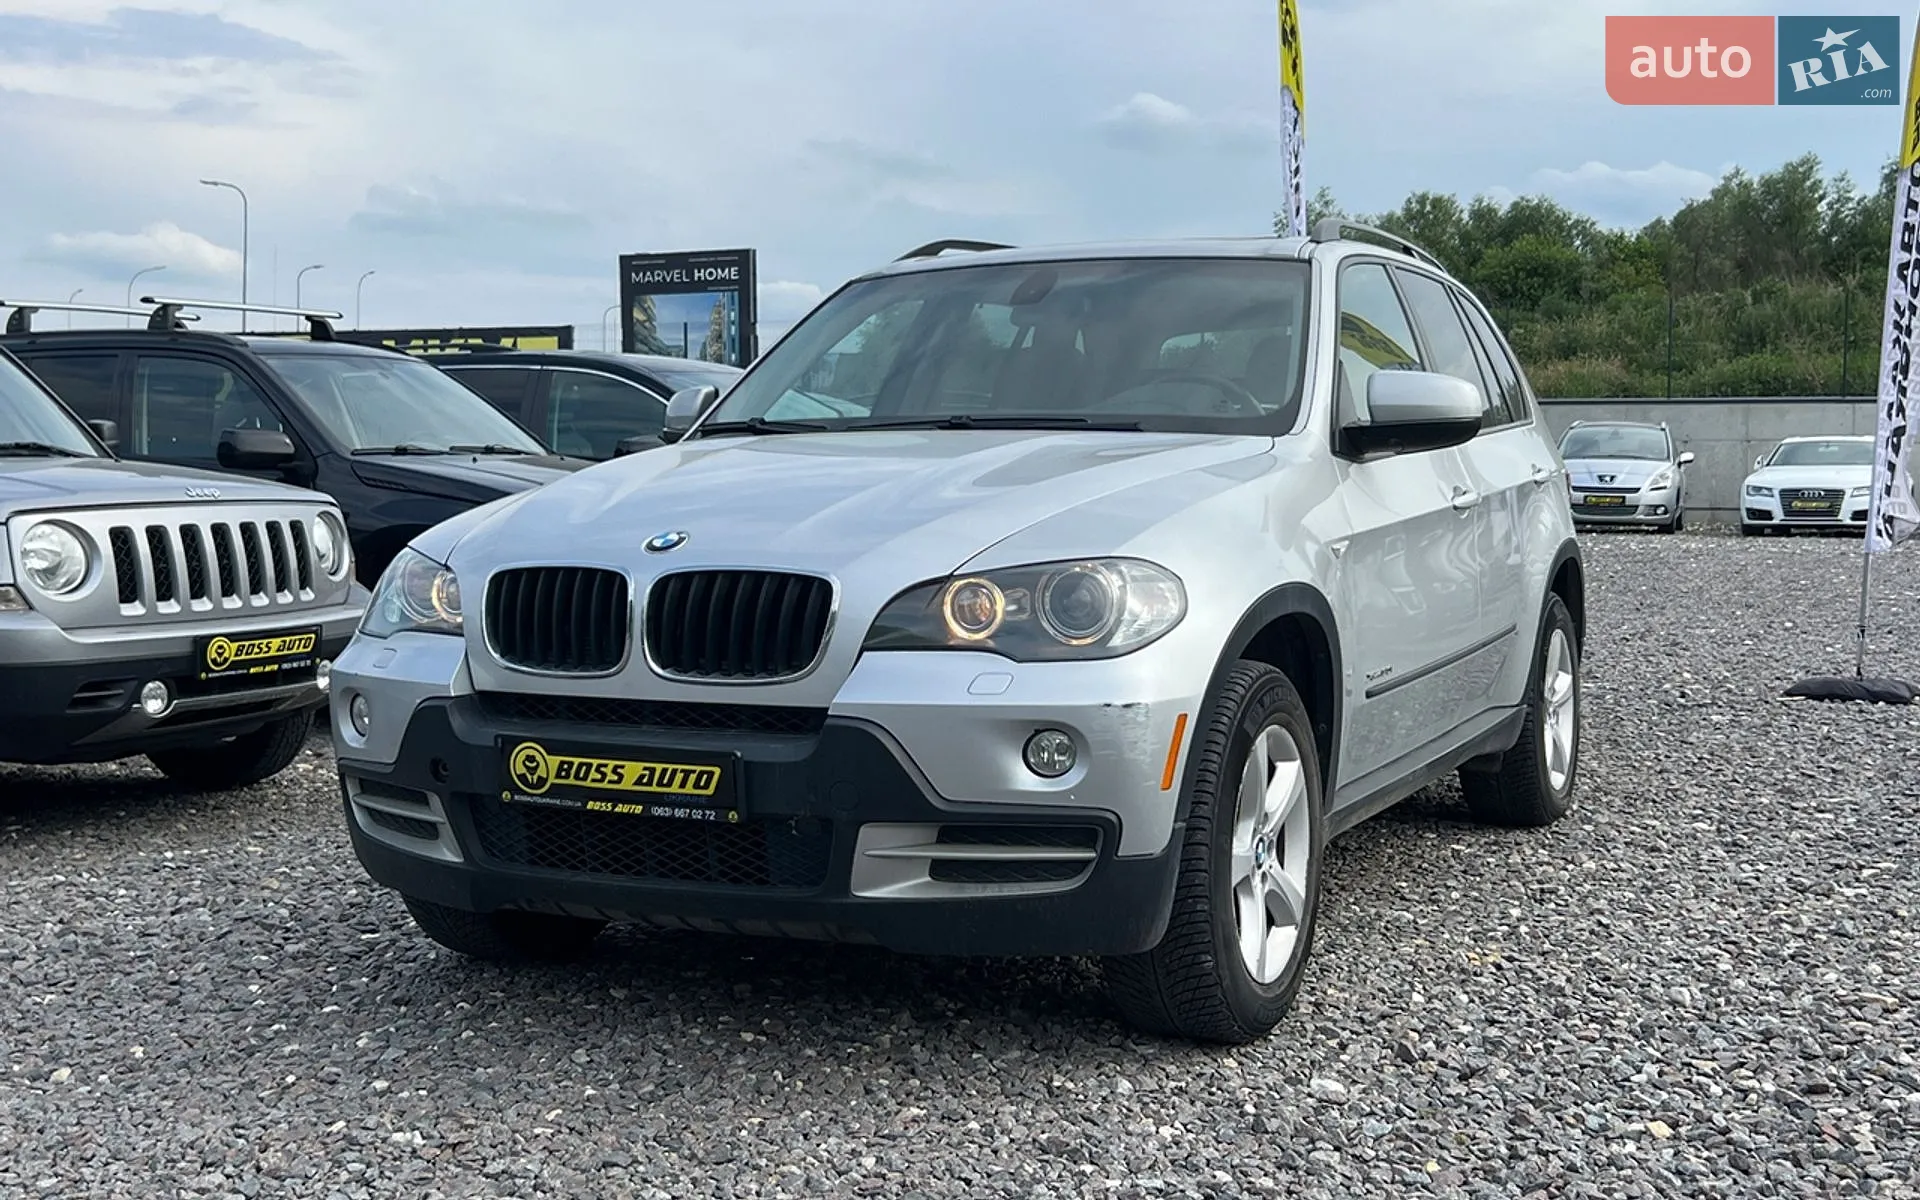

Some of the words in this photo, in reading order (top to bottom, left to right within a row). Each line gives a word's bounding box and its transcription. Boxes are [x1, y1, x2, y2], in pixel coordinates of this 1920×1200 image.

[631, 269, 690, 284] MARVEL
[694, 266, 740, 281] HOME
[184, 486, 221, 500] Jeep
[234, 640, 272, 657] BOSS
[275, 637, 313, 653] AUTO
[554, 760, 626, 785] BOSS
[631, 766, 717, 791] AUTO
[586, 801, 613, 812] BOSS
[613, 803, 643, 814] AUTO
[704, 810, 717, 820] 72
